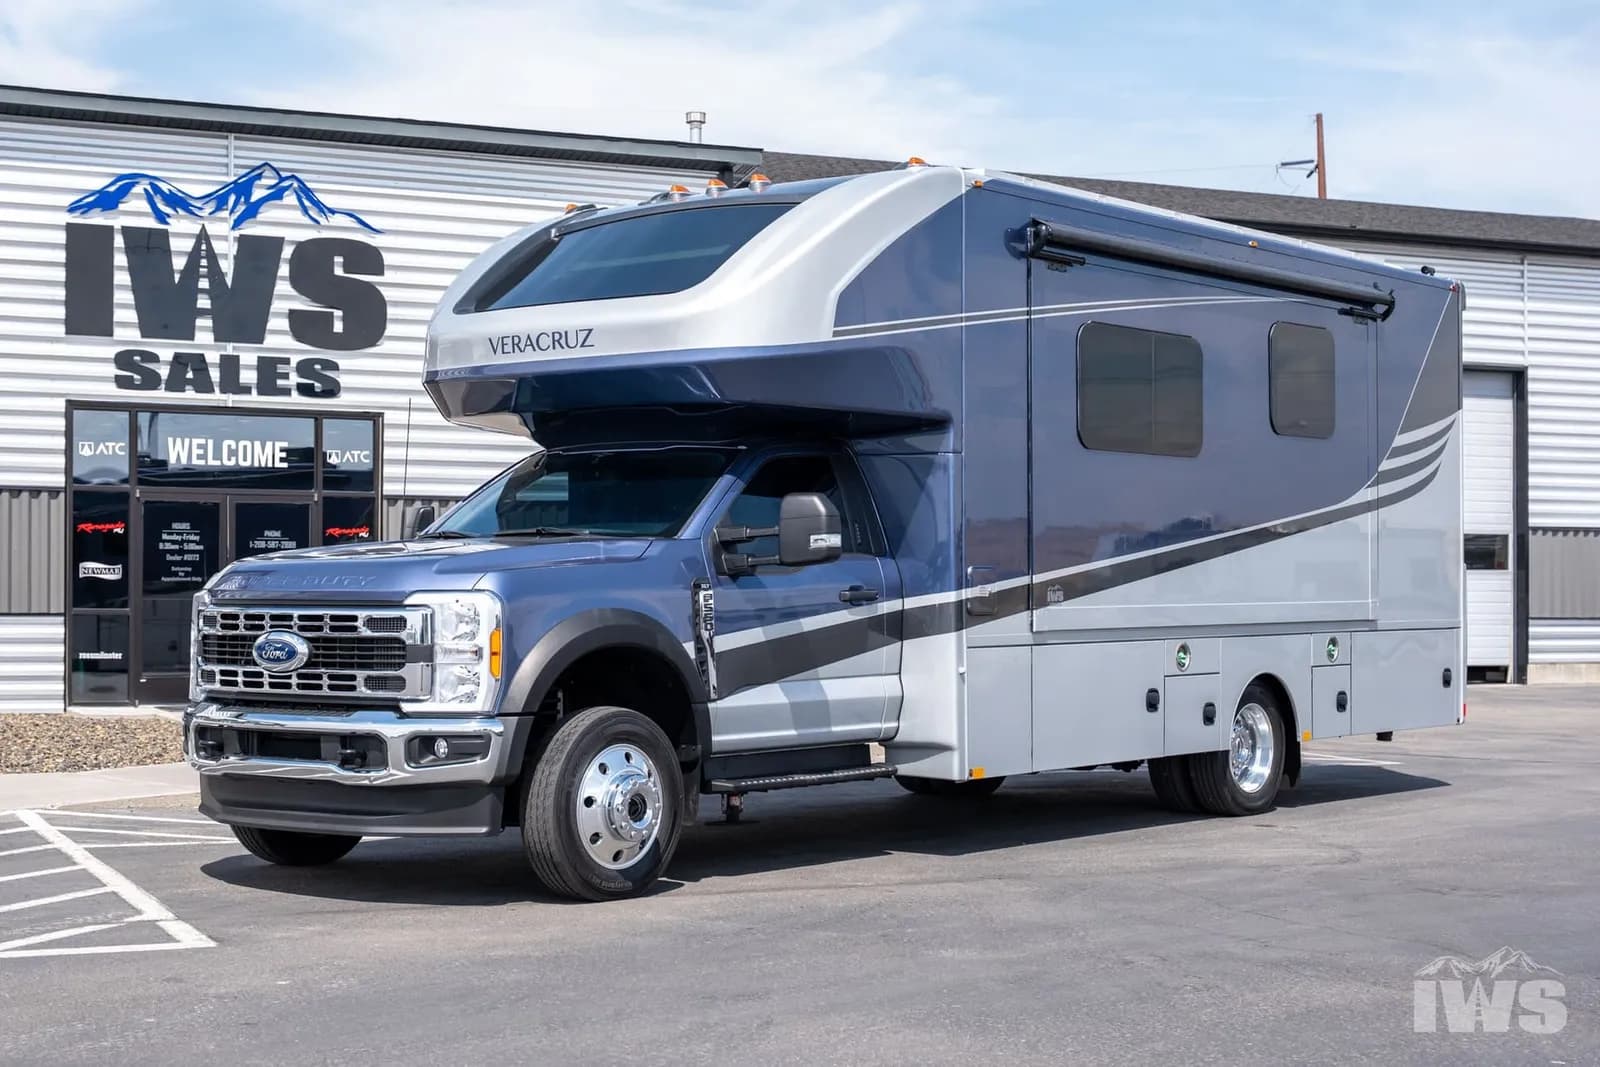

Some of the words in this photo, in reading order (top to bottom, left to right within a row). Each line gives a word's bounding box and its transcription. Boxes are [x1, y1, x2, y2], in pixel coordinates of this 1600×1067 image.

[65, 222, 387, 351] IWS
[488, 327, 595, 355] VERACRUZ
[113, 348, 341, 399] SALES
[95, 441, 126, 456] ATC
[167, 436, 289, 469] WELCOME
[342, 450, 371, 463] ATC
[81, 566, 121, 576] NEWMAR
[261, 642, 289, 660] Ford
